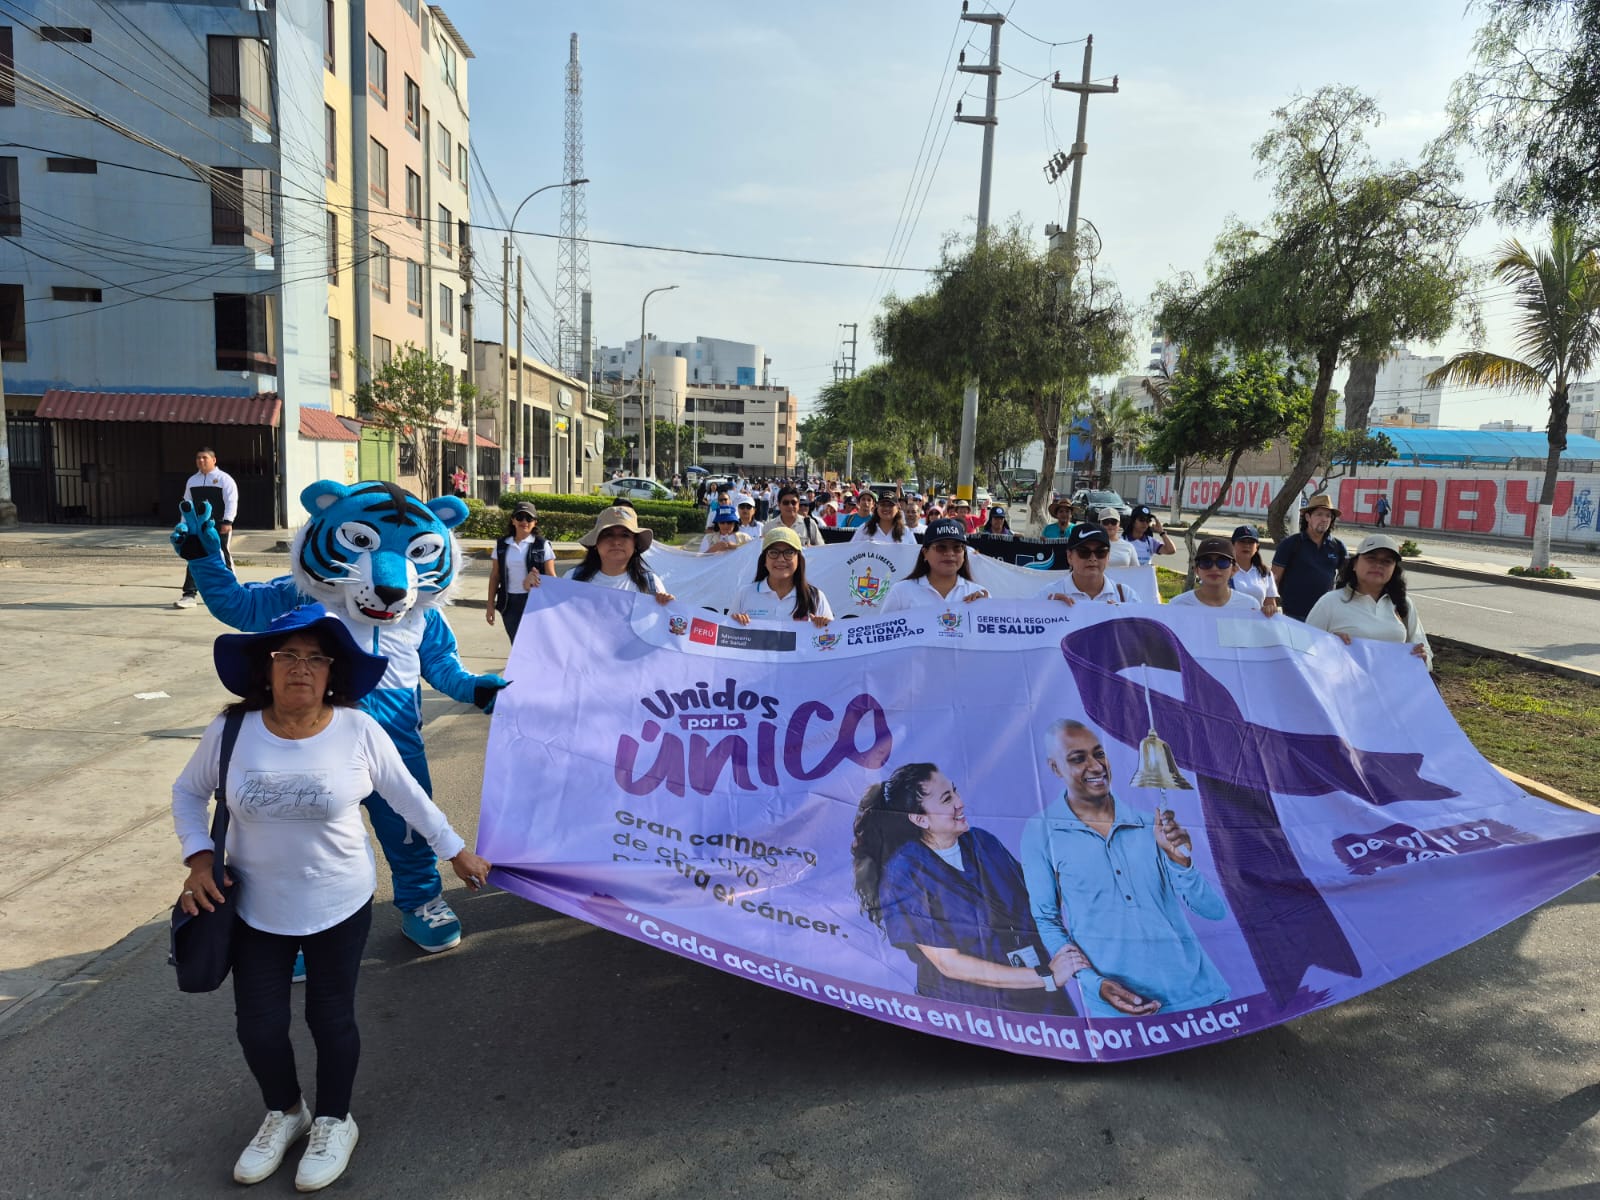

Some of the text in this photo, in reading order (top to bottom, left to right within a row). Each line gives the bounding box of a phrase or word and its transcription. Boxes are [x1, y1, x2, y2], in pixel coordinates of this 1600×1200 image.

[1337, 478, 1575, 538] GABY
[936, 525, 960, 536] MINSA
[867, 551, 875, 559] LA
[847, 618, 907, 634] GOBIERNO
[976, 615, 1070, 625] GERENCIA REGIONAL
[847, 625, 908, 639] REGIONAL
[847, 637, 863, 646] LA
[866, 628, 925, 644] LIBERTAD
[977, 624, 1046, 635] DE SALUD
[641, 678, 780, 720] Unidos
[687, 714, 739, 730] por lo
[615, 810, 682, 842] Gran
[689, 833, 817, 867] campaña
[1458, 826, 1491, 841] 07
[613, 832, 648, 852] de
[713, 883, 736, 907] el
[741, 900, 848, 940] cáncer.
[723, 953, 819, 995] acción
[823, 984, 923, 1024] cuenta
[927, 1011, 963, 1033] en
[967, 1010, 993, 1039] la
[998, 1016, 1081, 1051] lucha
[1084, 1028, 1132, 1059] por
[1140, 1023, 1170, 1047] la
